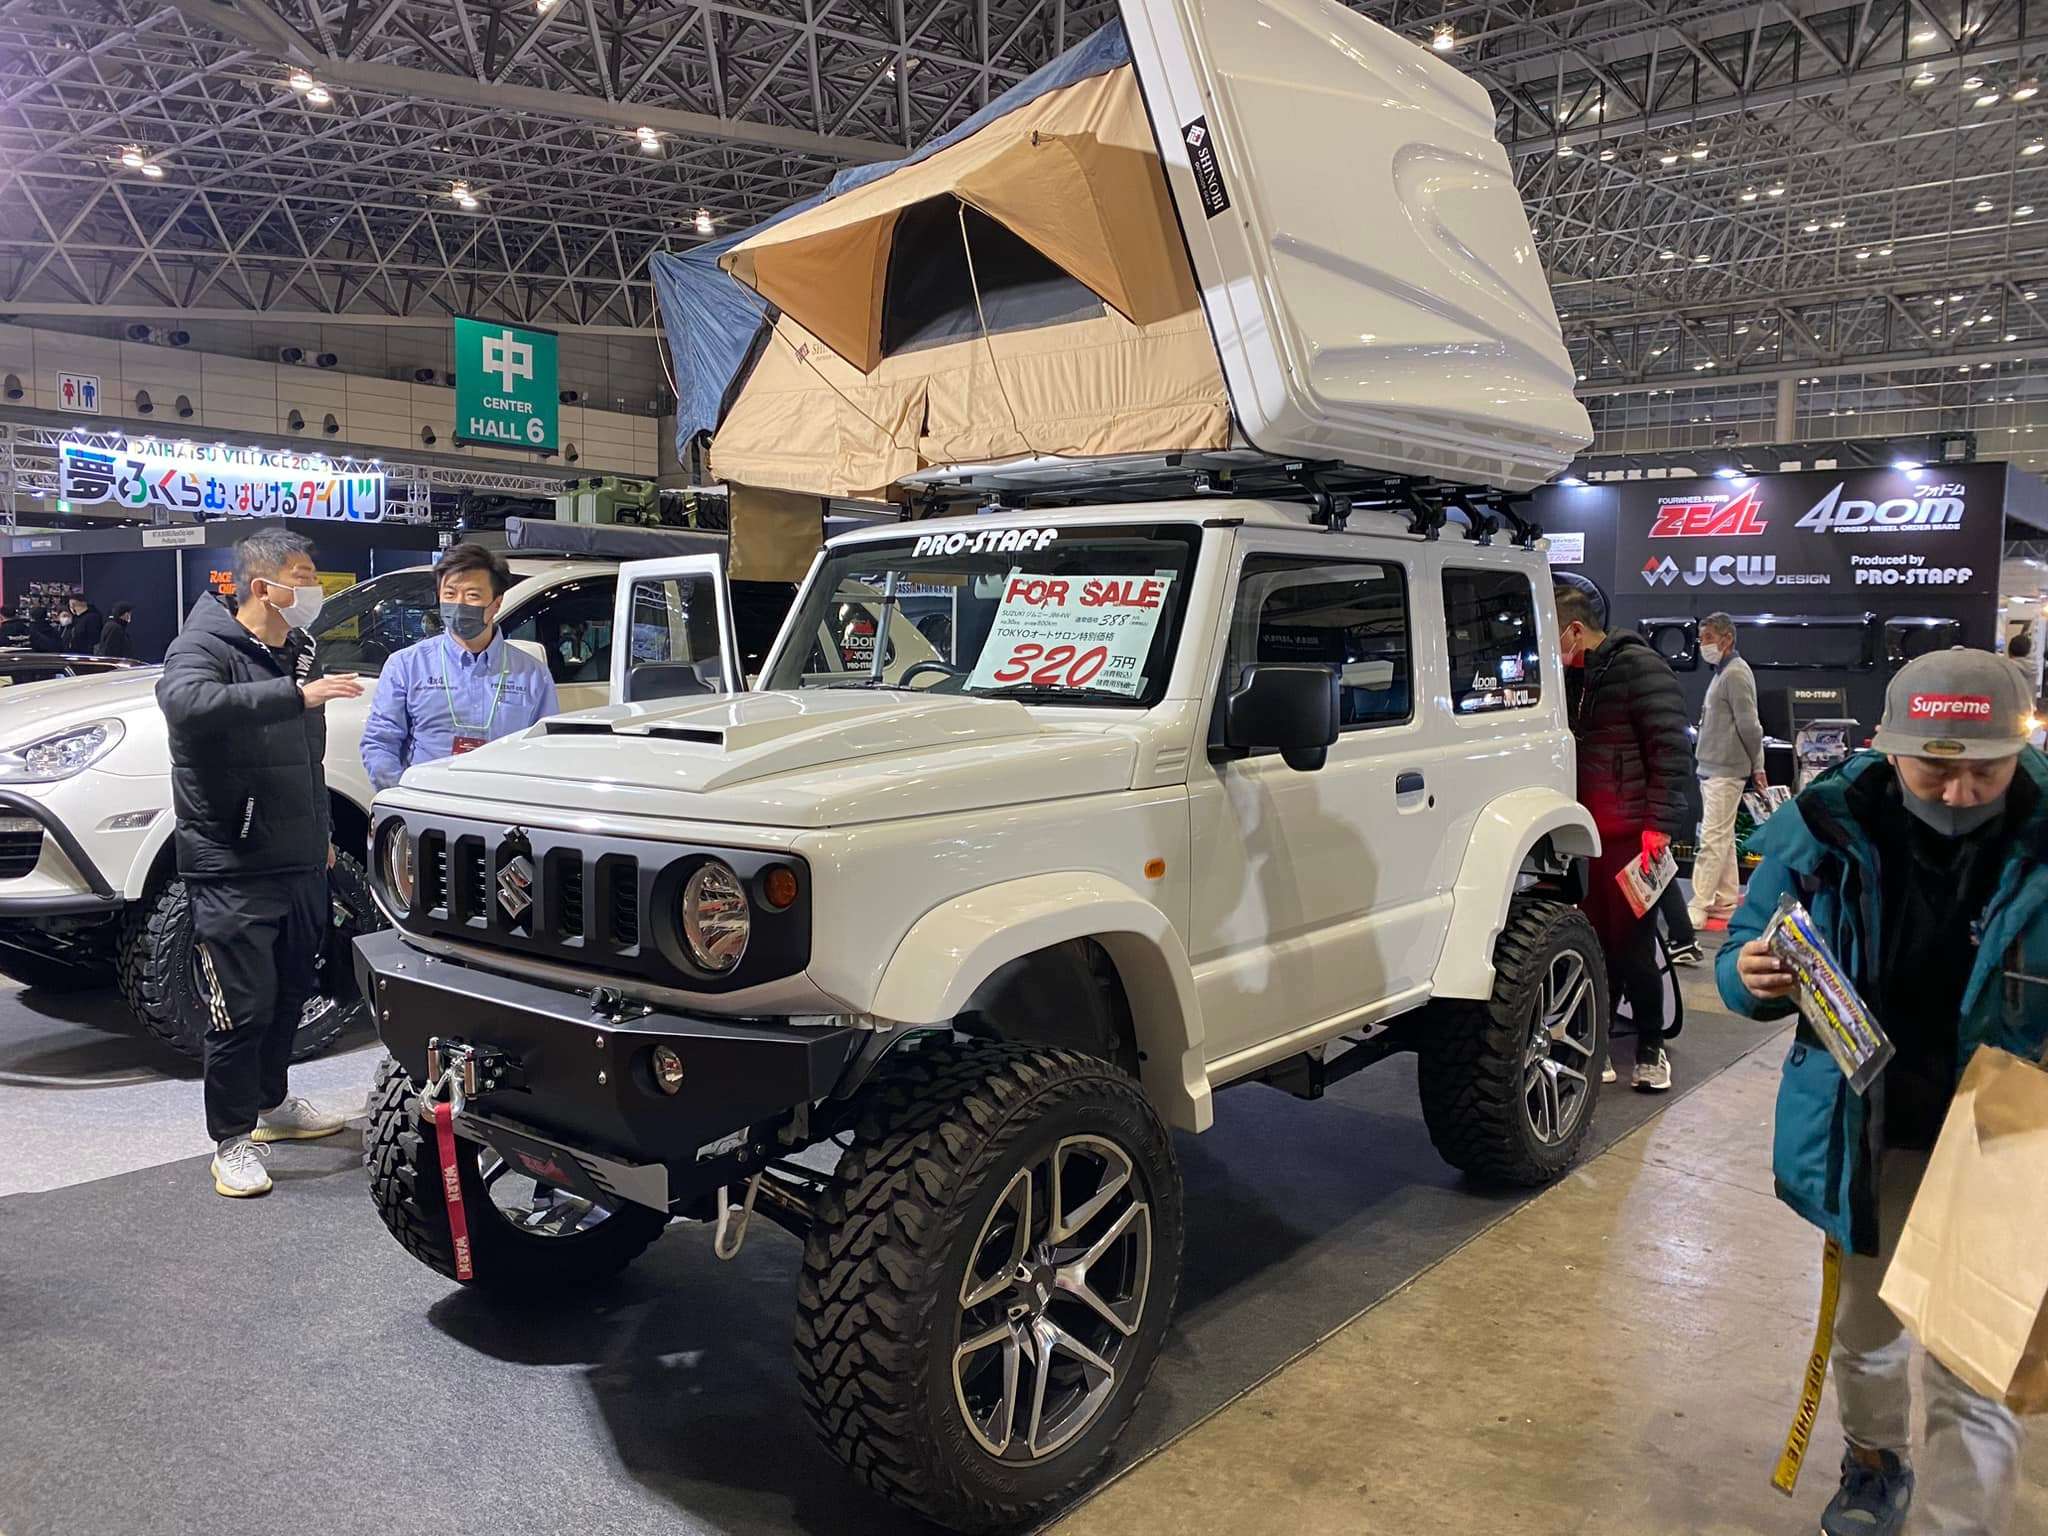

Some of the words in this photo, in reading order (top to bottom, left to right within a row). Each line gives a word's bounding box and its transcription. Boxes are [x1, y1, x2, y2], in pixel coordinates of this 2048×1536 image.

[1198, 147, 1224, 210] SHINOBI
[482, 329, 533, 393] 中
[483, 396, 533, 414] CENTER
[470, 417, 522, 440] HALL
[526, 417, 545, 443] 6
[135, 441, 217, 461] DAIHATSU
[1658, 496, 1702, 505] FOURWHEEL
[1914, 483, 1965, 497] フォドム
[1648, 482, 1768, 538] ZEAL
[1794, 481, 1966, 533] 4DOM
[911, 527, 1059, 558] PRO-STAFF
[1682, 555, 1776, 586] JCW
[1776, 574, 1830, 585] DESIGN
[1851, 554, 1906, 566] Produced
[1909, 554, 1925, 567] by
[210, 570, 232, 583] RACE
[1855, 567, 1973, 586] PRO-STAFF
[1005, 578, 1070, 609] FOR
[1079, 577, 1164, 610] SALE
[1098, 614, 1132, 626] 388
[997, 628, 1116, 642] TOKYOオートサロン特別価格
[994, 643, 1108, 687] 320
[1108, 655, 1137, 669] 万円
[1912, 696, 1990, 717] Supreme
[444, 1164, 460, 1202] WARN
[455, 1235, 471, 1273] WARN
[1786, 1353, 1825, 1463] OFF-WHITE
